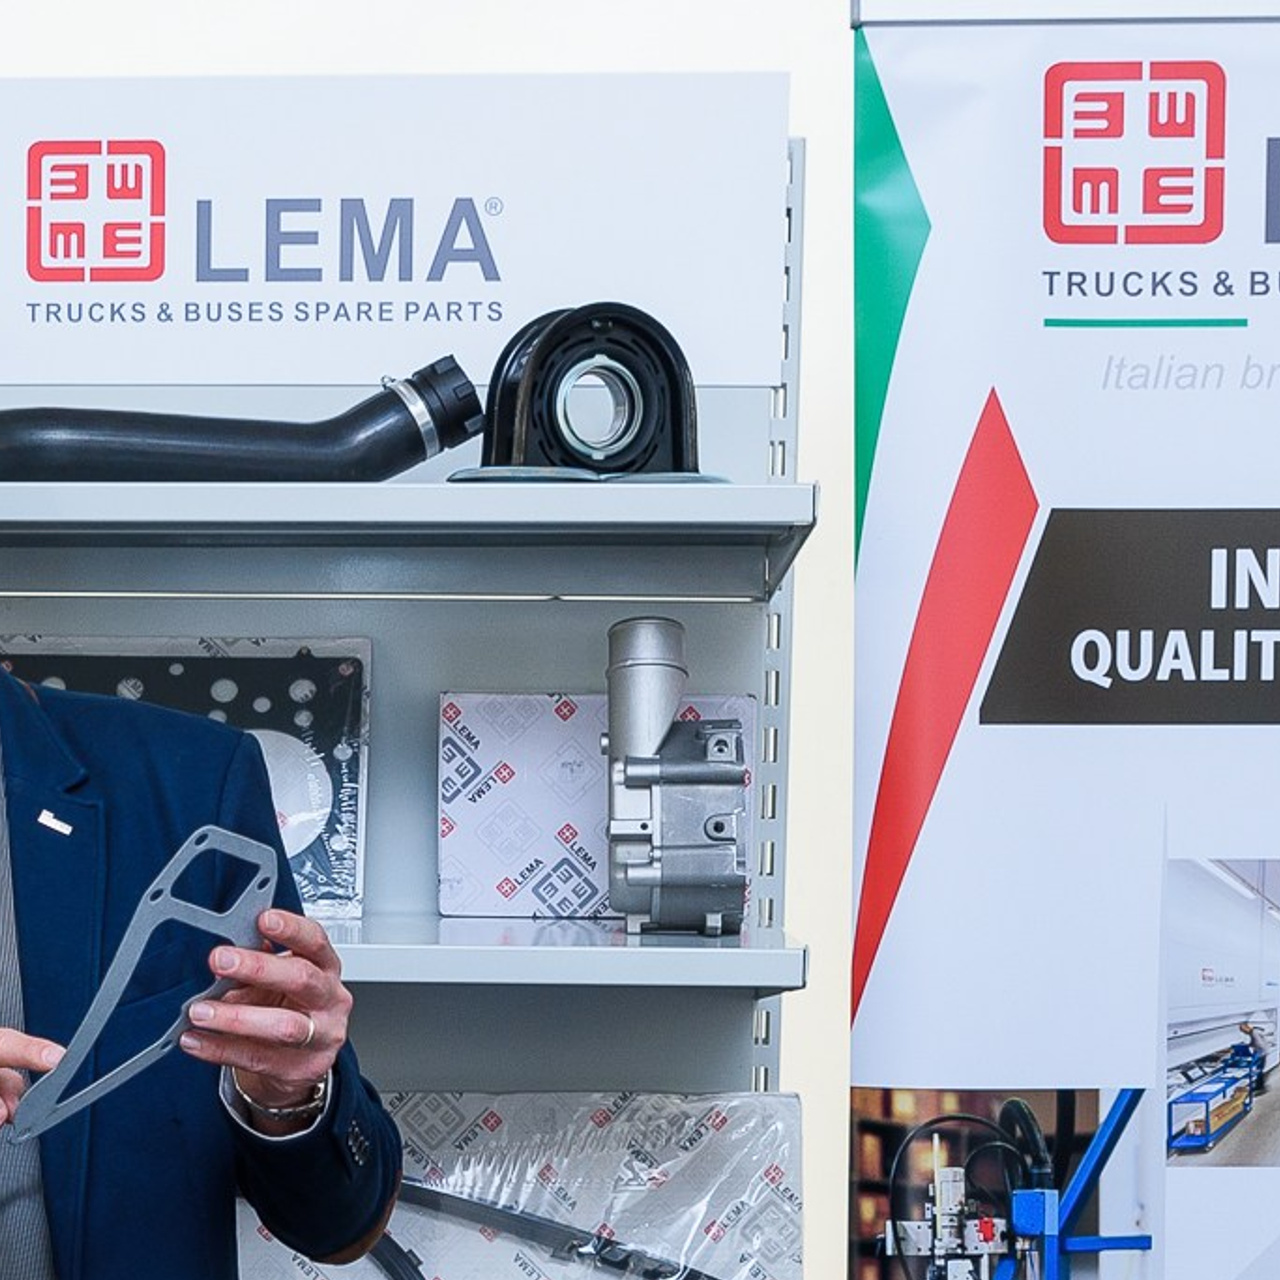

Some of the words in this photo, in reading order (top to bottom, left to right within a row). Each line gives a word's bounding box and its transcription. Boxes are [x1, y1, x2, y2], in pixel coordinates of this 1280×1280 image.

[196, 197, 502, 282] LEMA
[1041, 271, 1199, 297] TRUCKS
[1213, 270, 1235, 296] &
[26, 302, 147, 323] TRUCKS
[157, 302, 174, 322] &
[184, 302, 284, 322] BUSES
[294, 301, 394, 322] SPARE
[405, 301, 503, 321] PARTS
[1101, 355, 1225, 390] Italian
[1070, 628, 1280, 689] QUALIT
[453, 719, 481, 750] LEMA
[467, 776, 497, 804] LEMA
[515, 857, 544, 886] LEMA
[569, 841, 598, 872] LEMA
